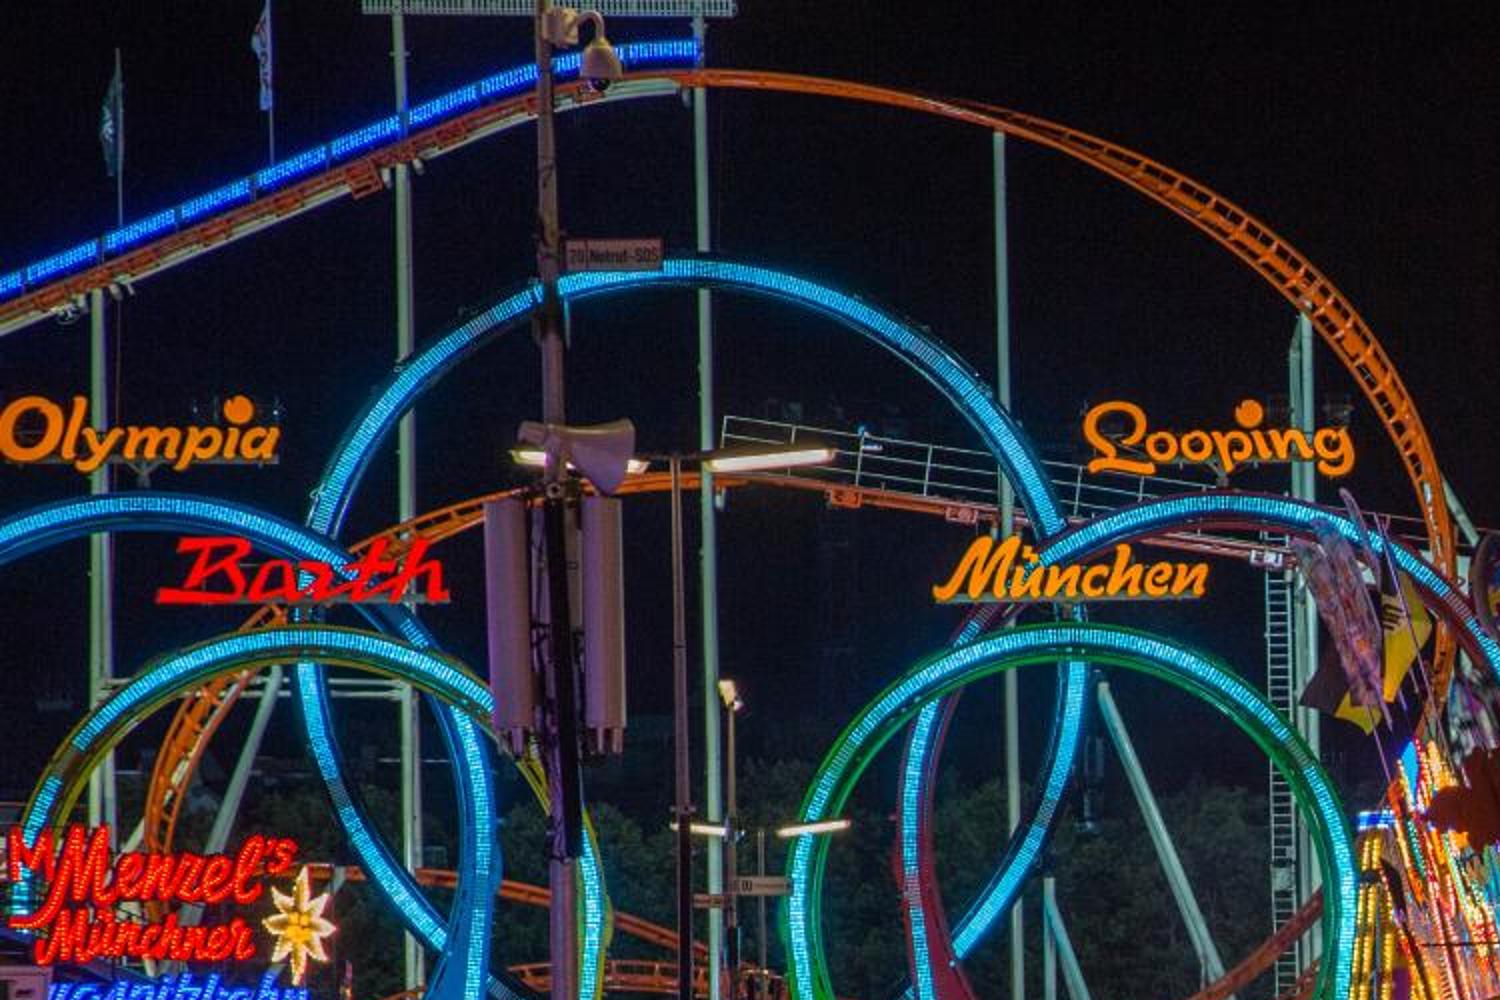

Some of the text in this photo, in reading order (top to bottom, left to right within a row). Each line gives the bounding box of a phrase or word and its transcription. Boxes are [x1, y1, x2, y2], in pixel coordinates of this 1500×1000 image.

[0, 395, 280, 472] Olympia
[1083, 399, 1357, 477] Looping
[155, 537, 450, 605] Barth
[932, 535, 1210, 601] München
